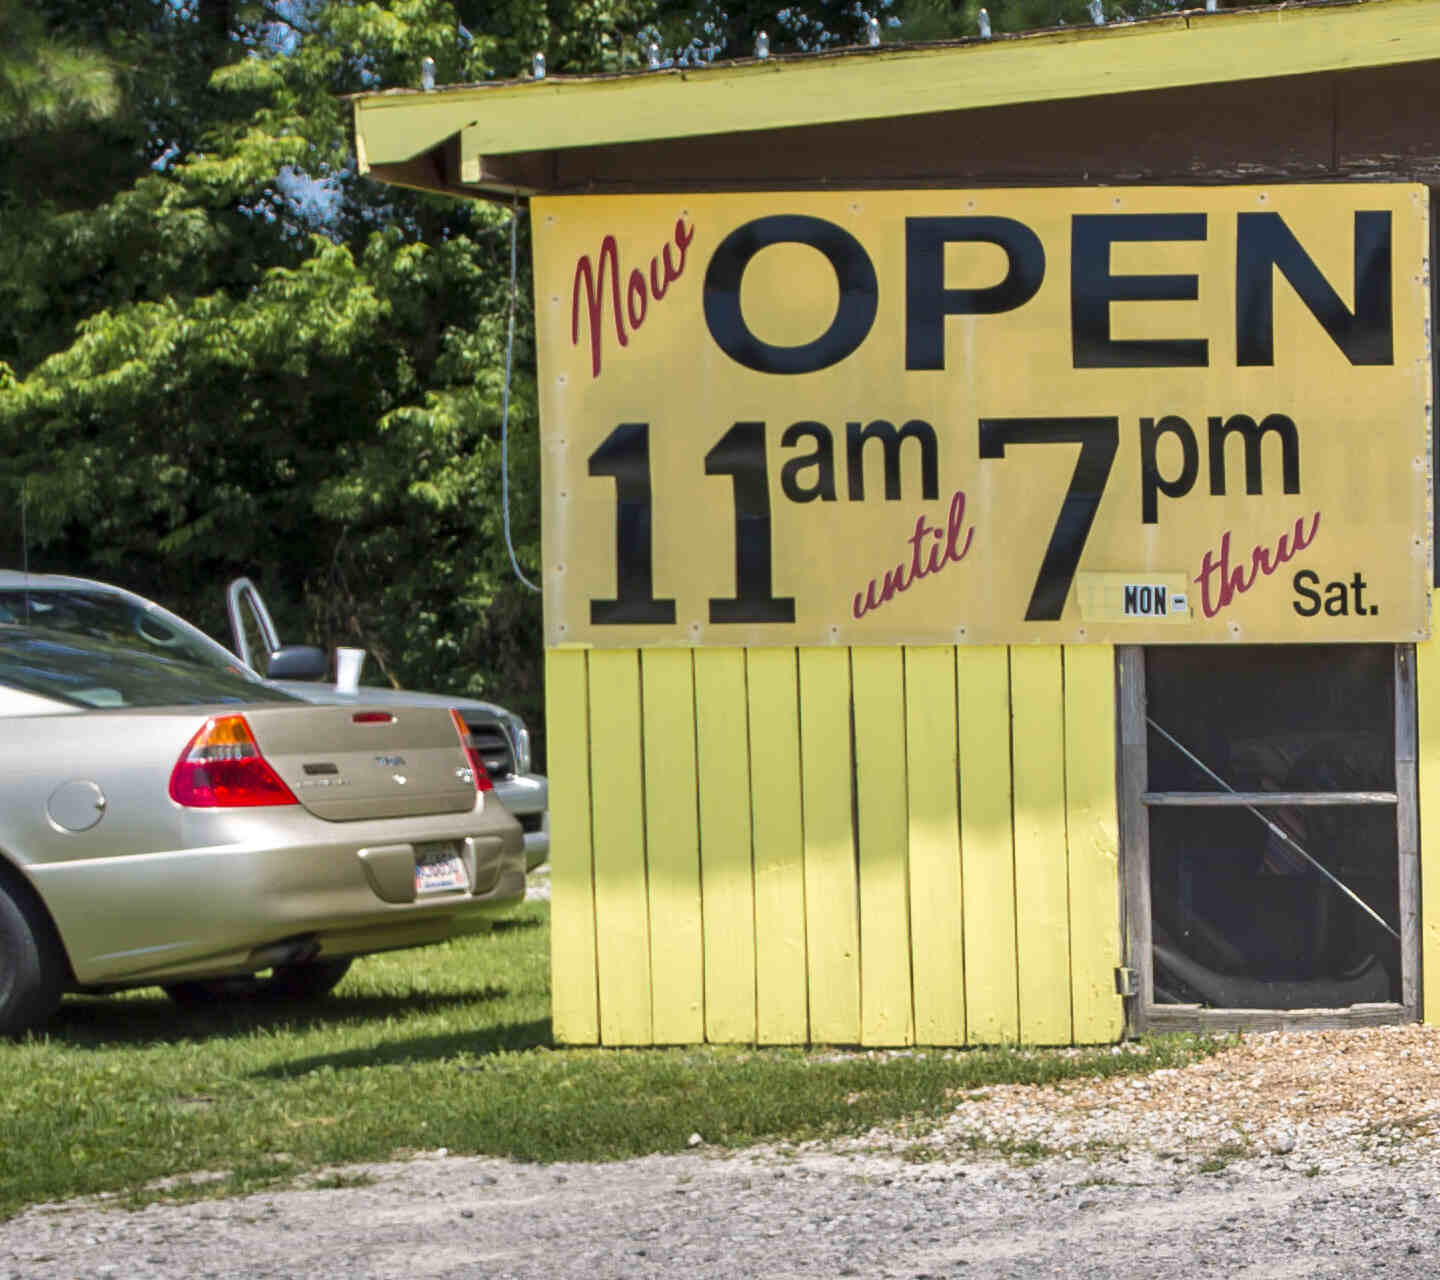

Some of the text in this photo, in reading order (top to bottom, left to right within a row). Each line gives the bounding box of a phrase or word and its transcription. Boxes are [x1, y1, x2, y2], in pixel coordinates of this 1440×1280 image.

[571, 210, 1394, 378] Now OPEN
[852, 490, 975, 619] until
[1193, 511, 1321, 618] thru
[1291, 569, 1380, 618] Sat.
